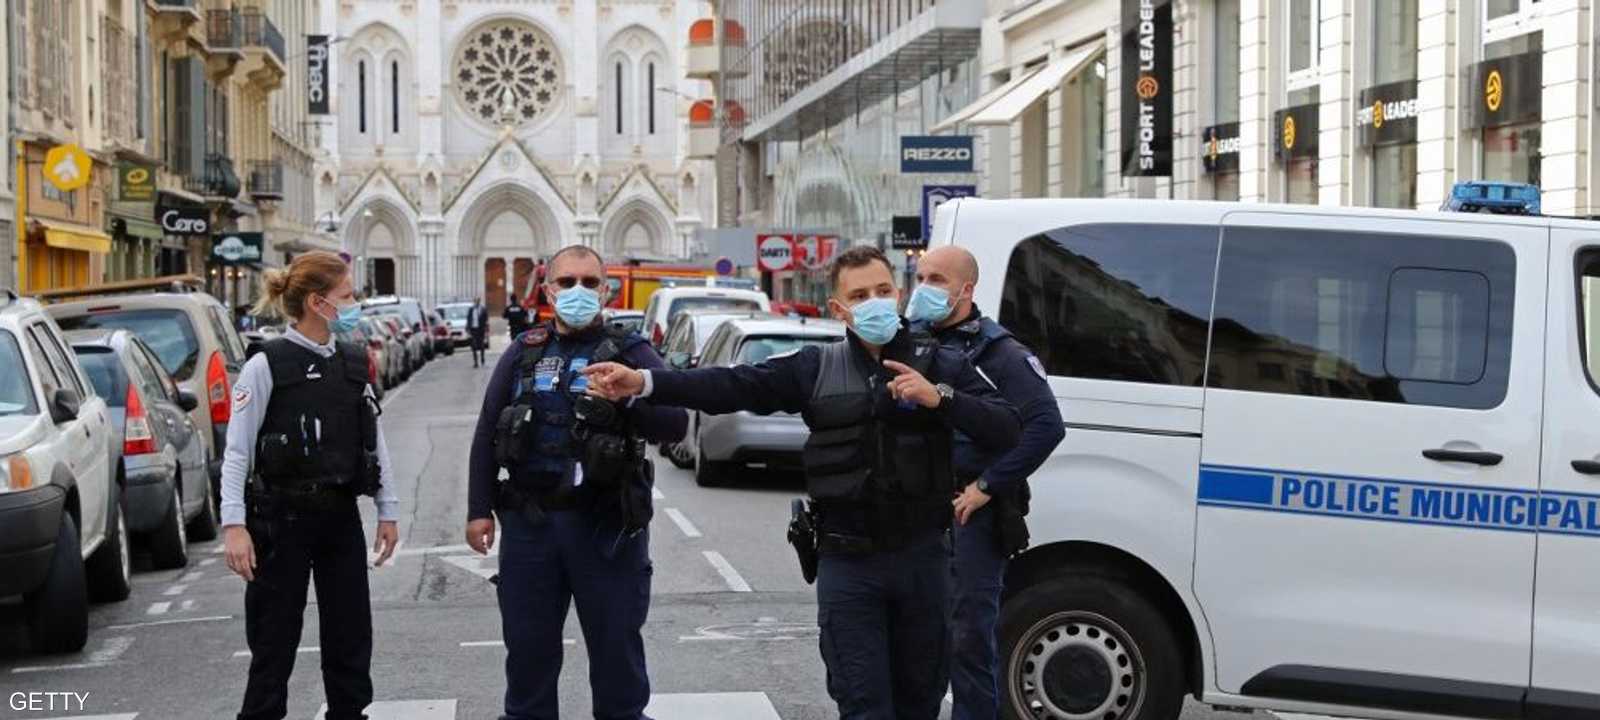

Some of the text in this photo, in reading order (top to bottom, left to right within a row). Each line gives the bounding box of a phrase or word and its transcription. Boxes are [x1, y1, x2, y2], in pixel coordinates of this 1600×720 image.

[309, 45, 327, 103] fnac
[903, 148, 971, 160] REZZO
[1140, 102, 1154, 169] SPORT
[761, 247, 789, 257] DARTY
[1280, 478, 1600, 530] POLICE MUNICIPAL
